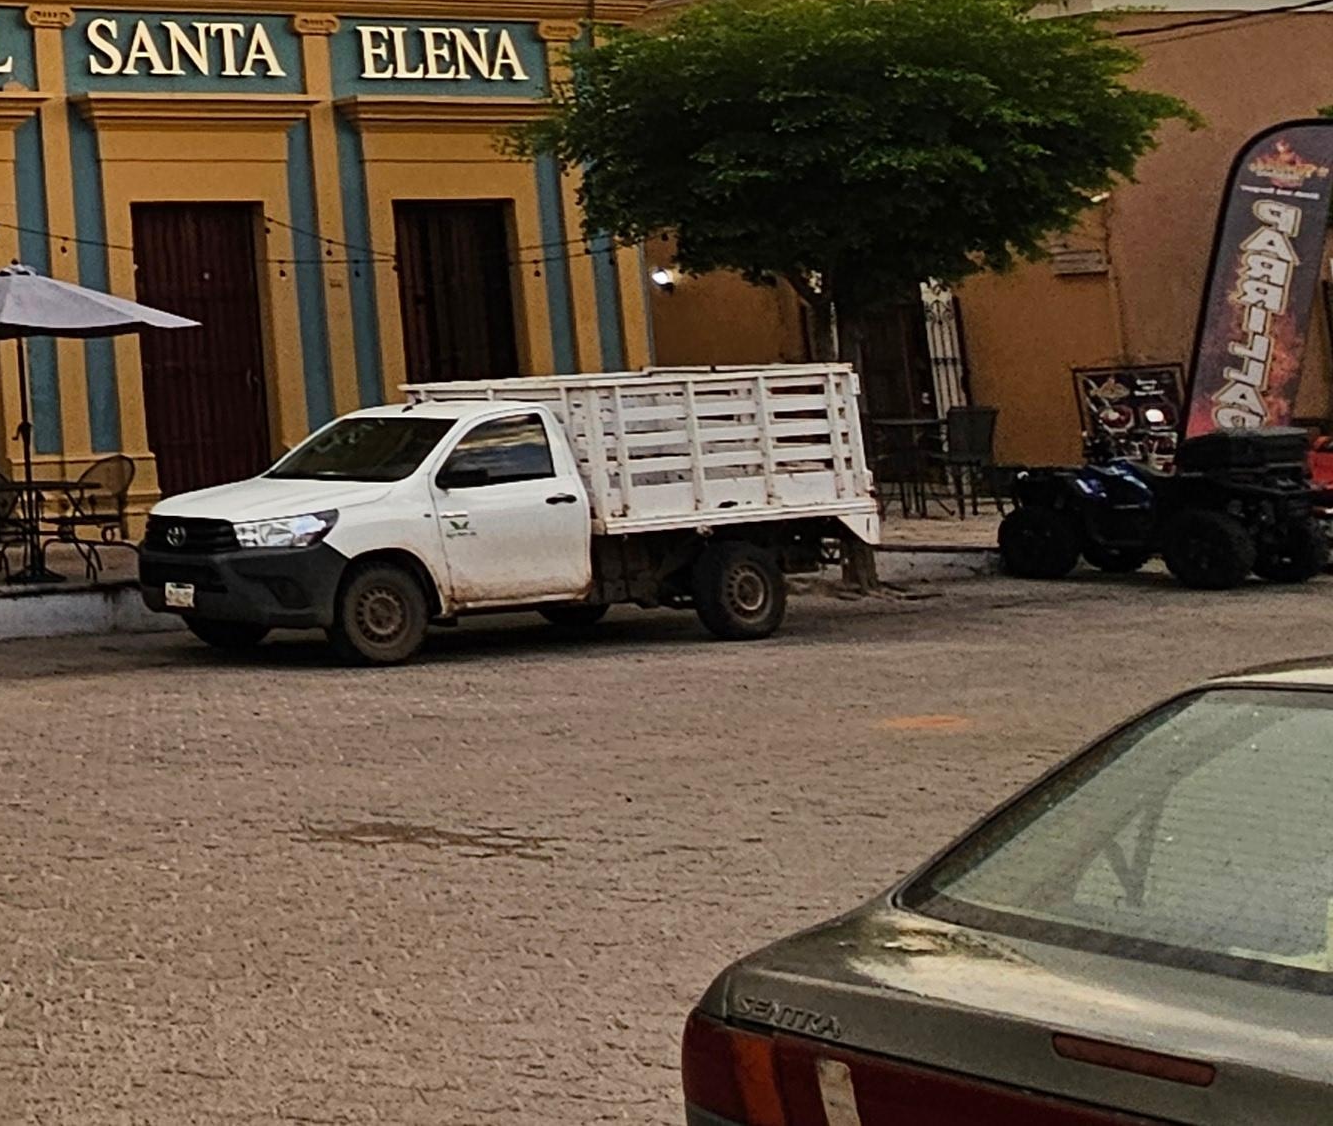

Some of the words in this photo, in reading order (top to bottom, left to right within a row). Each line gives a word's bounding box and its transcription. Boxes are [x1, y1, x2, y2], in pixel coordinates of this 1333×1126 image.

[87, 18, 288, 78] SANTA
[356, 25, 531, 81] ELENA
[734, 994, 842, 1040] SENTRA
